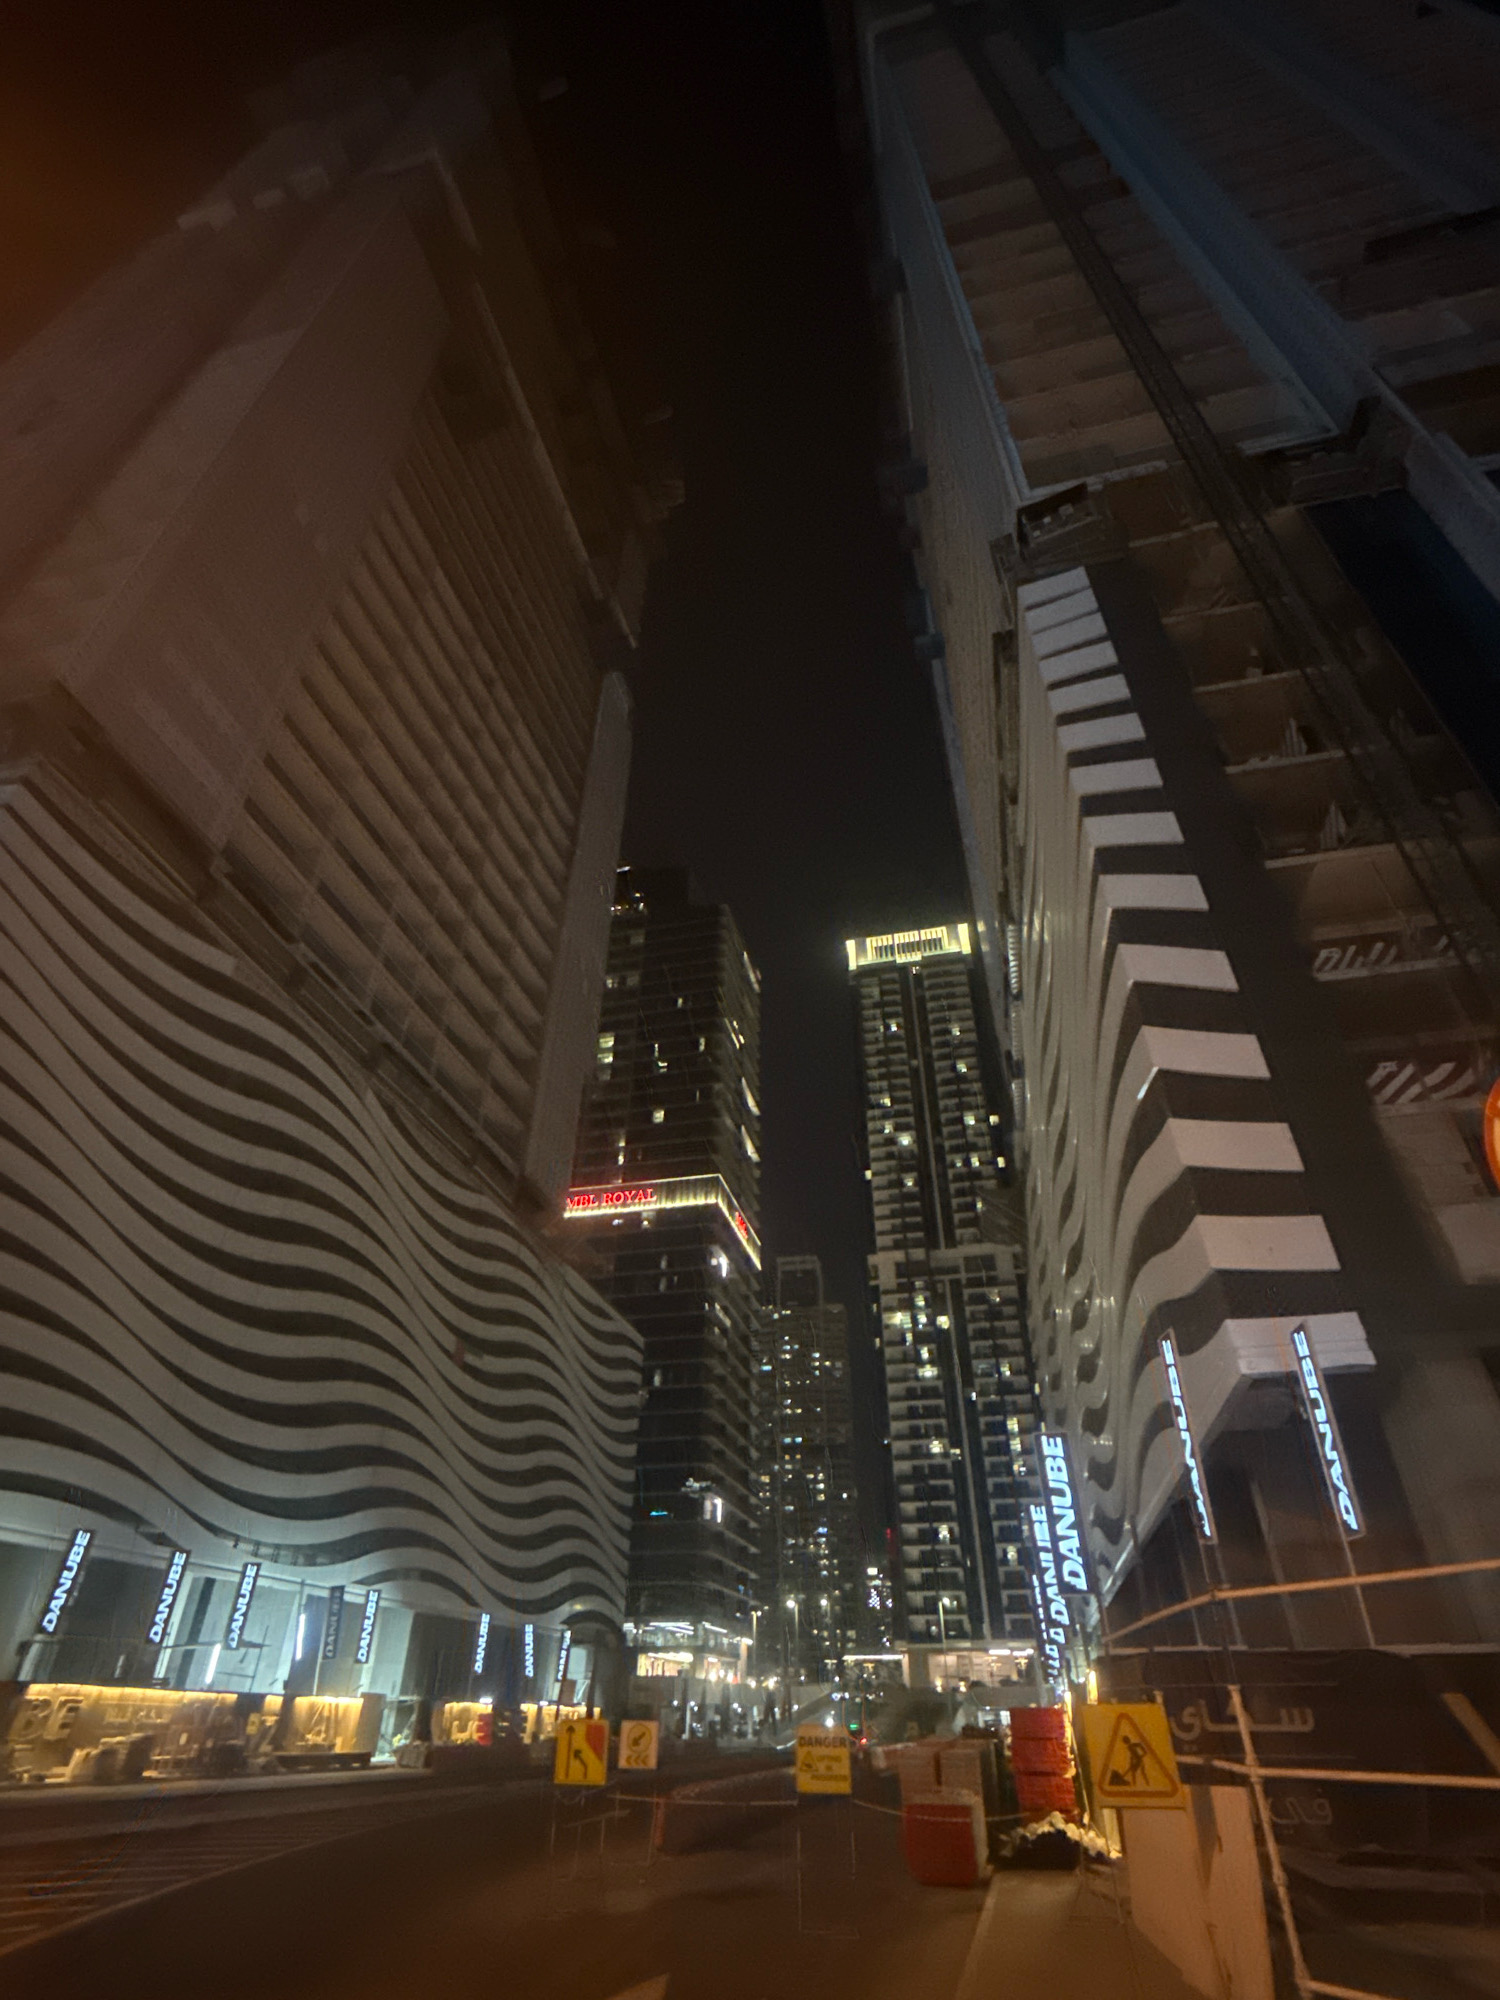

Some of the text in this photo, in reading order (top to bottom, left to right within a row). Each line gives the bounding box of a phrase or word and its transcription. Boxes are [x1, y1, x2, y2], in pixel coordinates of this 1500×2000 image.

[566, 1188, 657, 1208] MBL ROYAL
[1294, 1331, 1359, 1530] DANUBE
[1042, 1434, 1088, 1591] DANUBE
[42, 1530, 91, 1632] DANUBE
[150, 1551, 187, 1644] DANUBE
[228, 1564, 258, 1649] DANUBE
[357, 1590, 379, 1663] DANUBE
[474, 1613, 491, 1674] DANUBE
[524, 1623, 535, 1678] DANUBE
[798, 1735, 847, 1748] DANGER
